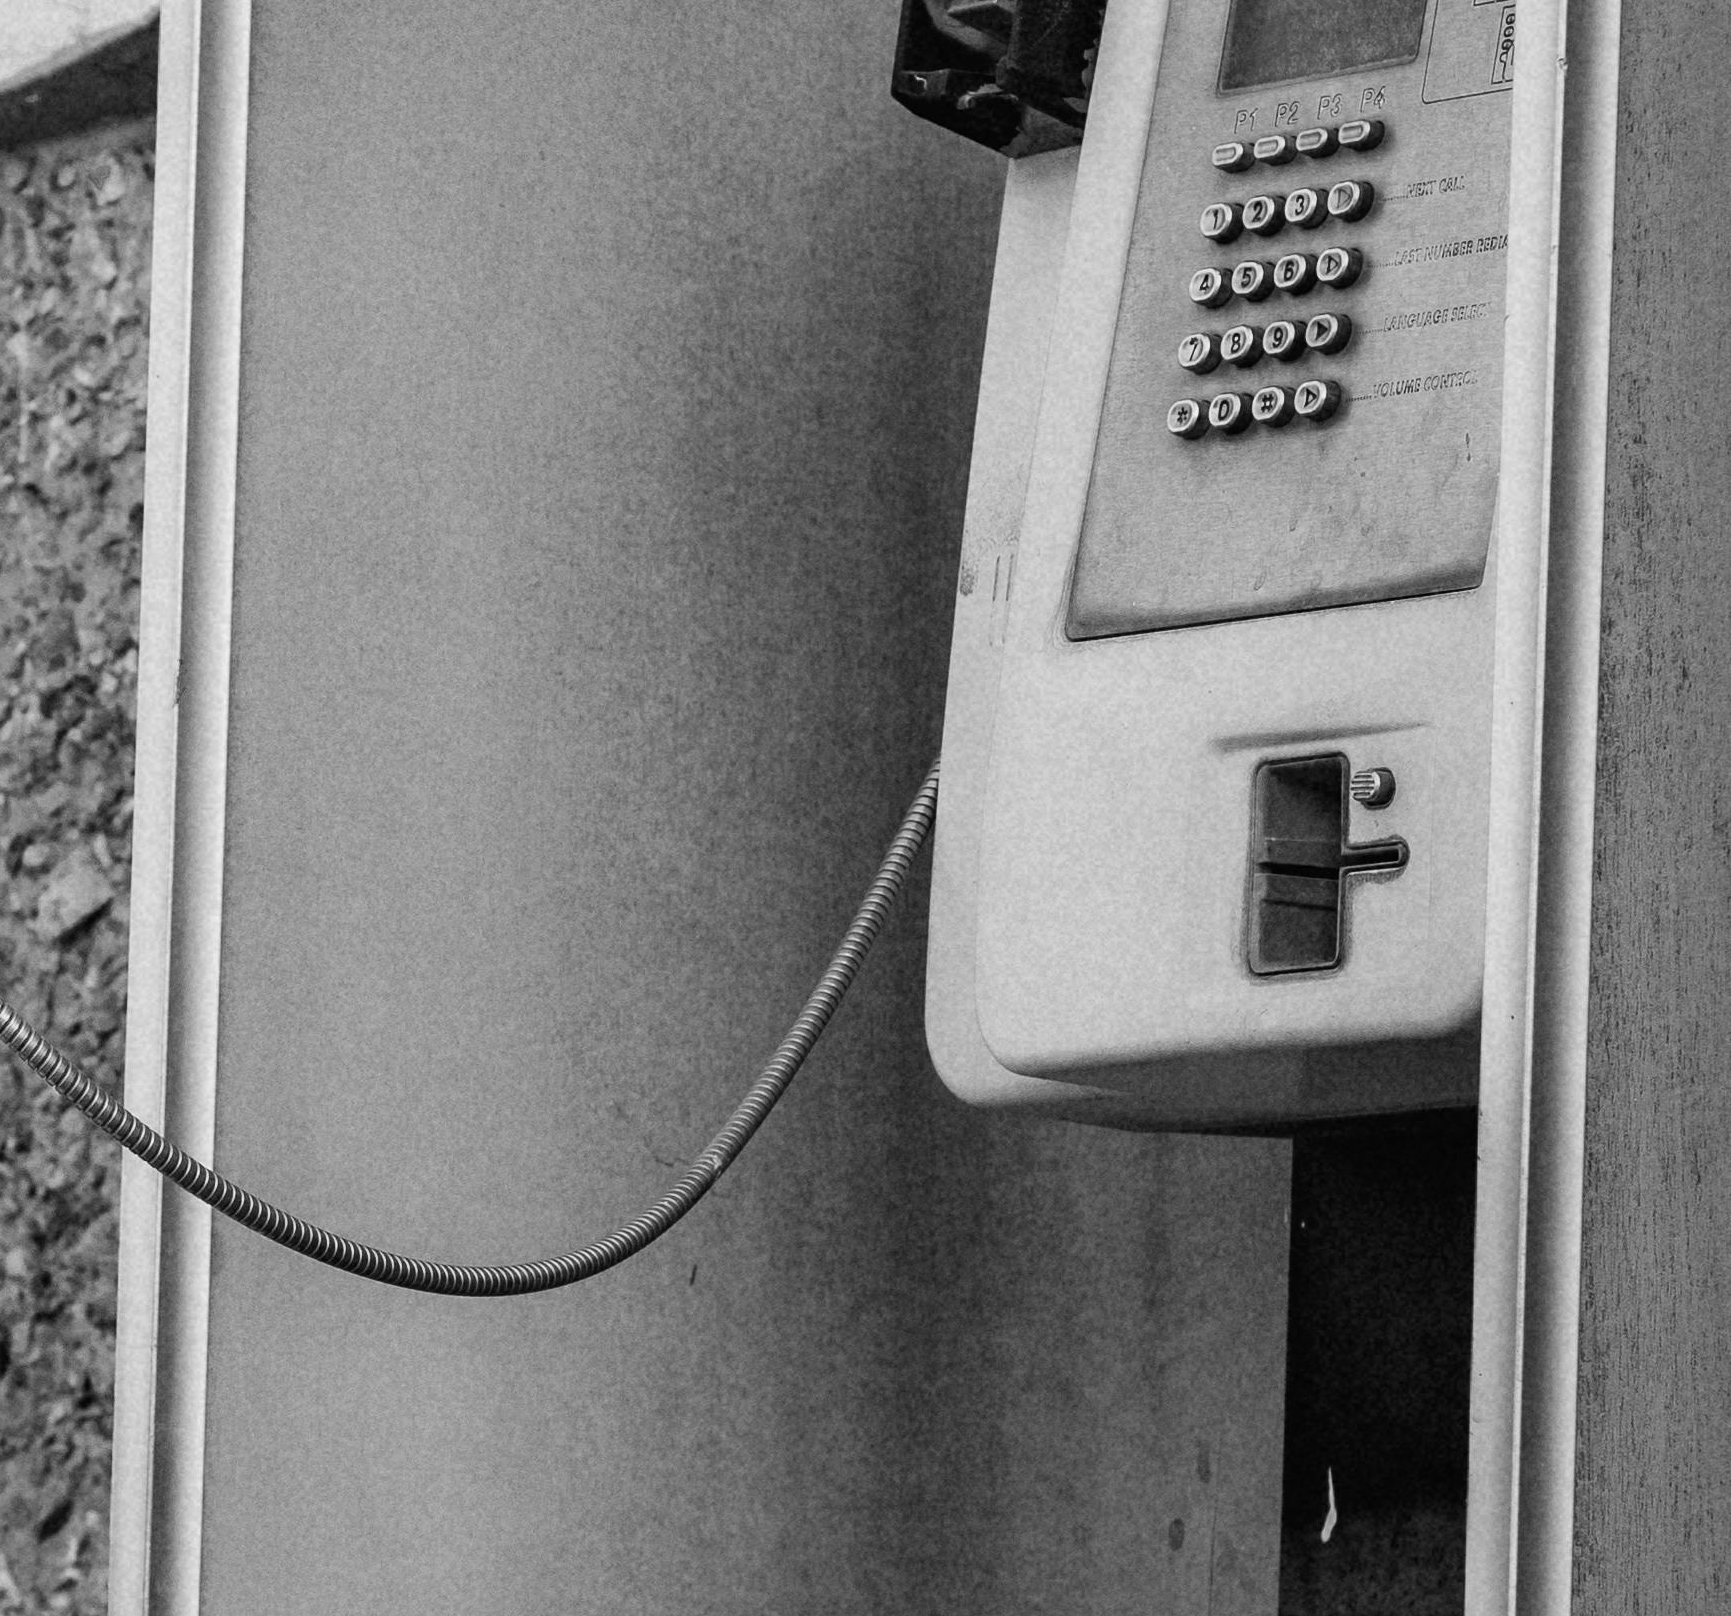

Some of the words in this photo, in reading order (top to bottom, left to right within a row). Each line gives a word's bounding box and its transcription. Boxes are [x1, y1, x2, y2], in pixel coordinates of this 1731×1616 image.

[1234, 108, 1259, 134] P1
[1274, 101, 1300, 127] P2
[1317, 93, 1342, 119] P3
[1360, 85, 1386, 112] P4
[1406, 179, 1436, 199] NEXT
[1438, 176, 1465, 193] CALL
[1211, 209, 1220, 231] 1
[1253, 201, 1264, 222] 2
[1295, 194, 1306, 216] 3
[1394, 248, 1423, 266] LAST
[1424, 240, 1473, 262] NUMBER
[1476, 233, 1508, 254] REDIA
[1199, 273, 1210, 293] 4
[1241, 267, 1252, 288] 5
[1283, 259, 1294, 280] 6
[1383, 309, 1449, 332] LANGUAGE
[1451, 302, 1492, 322] SELECT
[1189, 338, 1199, 361] 7
[1230, 333, 1241, 354] 8
[1272, 327, 1283, 348] 9
[1373, 377, 1421, 400] VOLUME
[1424, 369, 1478, 392] CONTROL
[1217, 399, 1229, 421] 0
[1261, 393, 1274, 413] #
